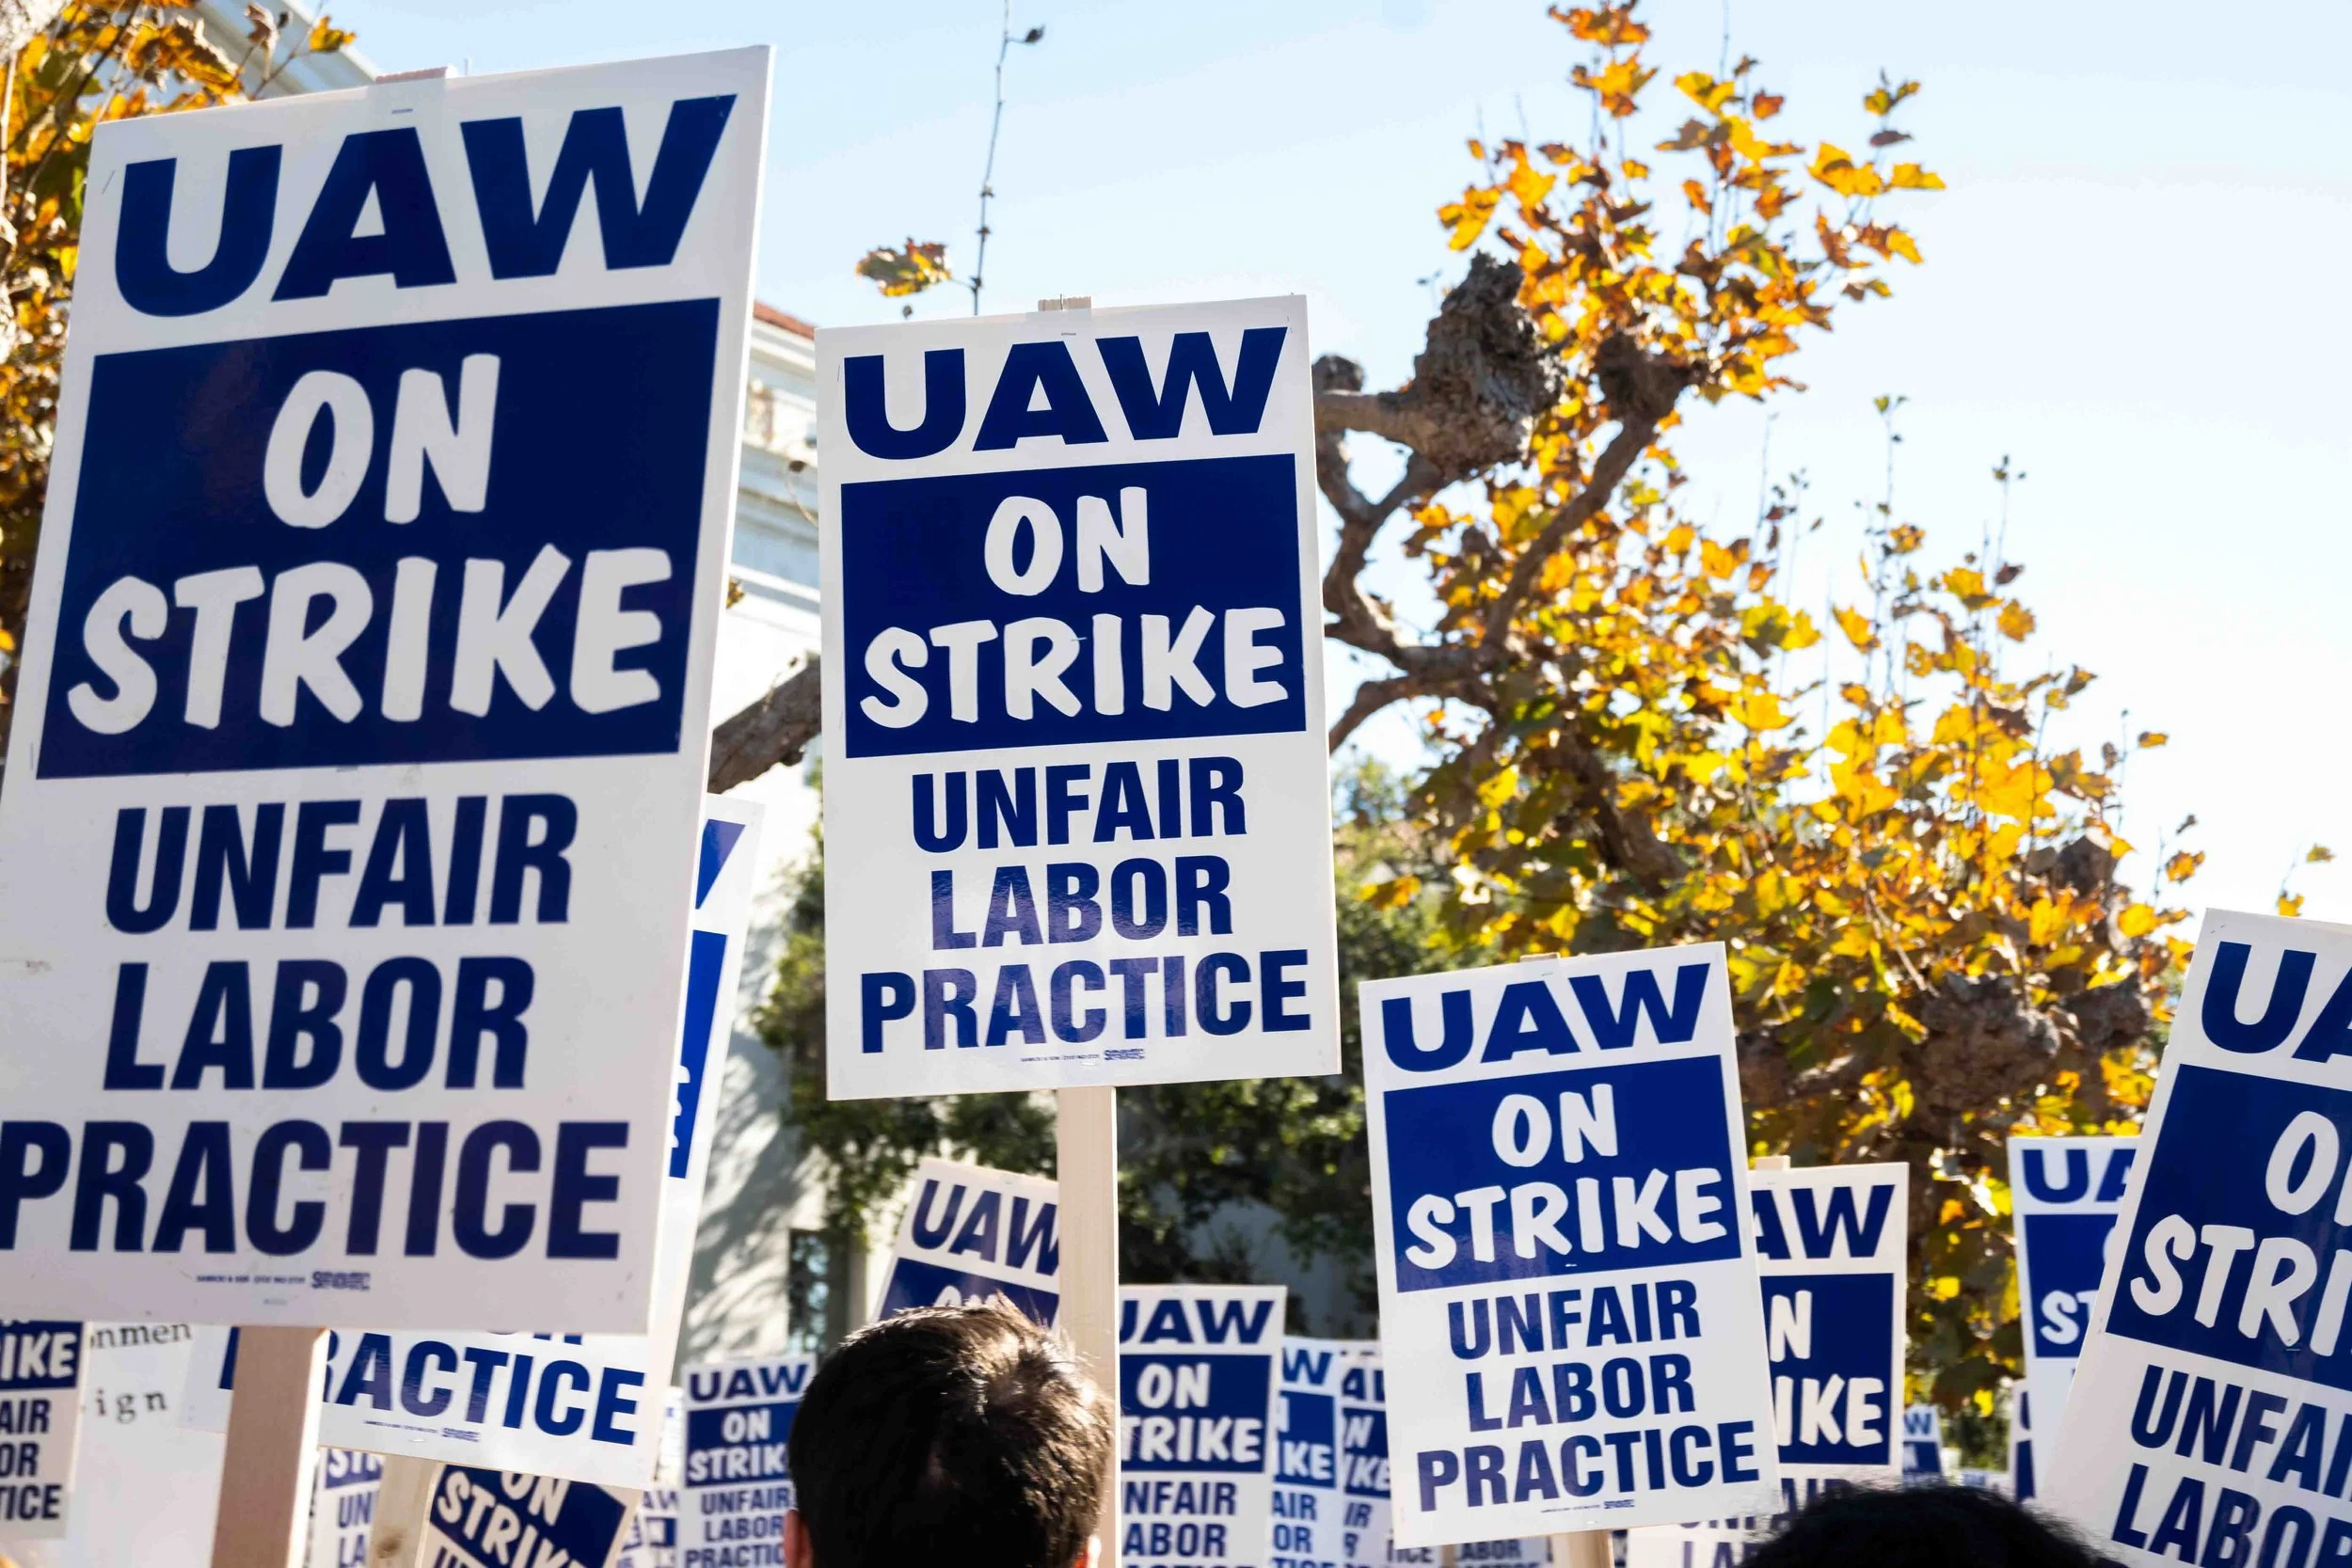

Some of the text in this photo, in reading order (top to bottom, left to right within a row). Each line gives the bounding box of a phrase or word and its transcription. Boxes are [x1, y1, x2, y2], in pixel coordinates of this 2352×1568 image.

[115, 94, 738, 317] UAW
[263, 354, 501, 529] ON
[844, 326, 1287, 461] UAW
[984, 486, 1150, 595] ON
[68, 543, 672, 735] STRIKE
[860, 605, 1289, 728] STRIKE
[913, 756, 1247, 853] UNFAIR
[105, 794, 579, 934] UNFAIR
[930, 856, 1232, 950] LABOR
[103, 957, 535, 1090] LABOR
[861, 950, 1311, 1054] PRACTICE
[1381, 962, 1710, 1072] UAW
[1492, 1084, 1618, 1167] ON
[2265, 1110, 2352, 1227] O
[0, 1120, 630, 1259] PRACTICE
[913, 1179, 1059, 1276] UAW
[1406, 1168, 1727, 1270] STRIKE
[1447, 1279, 1701, 1361] UNFAIR
[2129, 1213, 2352, 1357] STRI
[219, 1327, 645, 1446] ACTICE
[690, 1364, 809, 1402] UAW
[723, 1408, 771, 1443] ON
[1136, 1363, 1211, 1409] ON
[1466, 1353, 1693, 1432] LABOR
[701, 1487, 790, 1515] UNFAIR
[1417, 1420, 1759, 1511] PRACTICE
